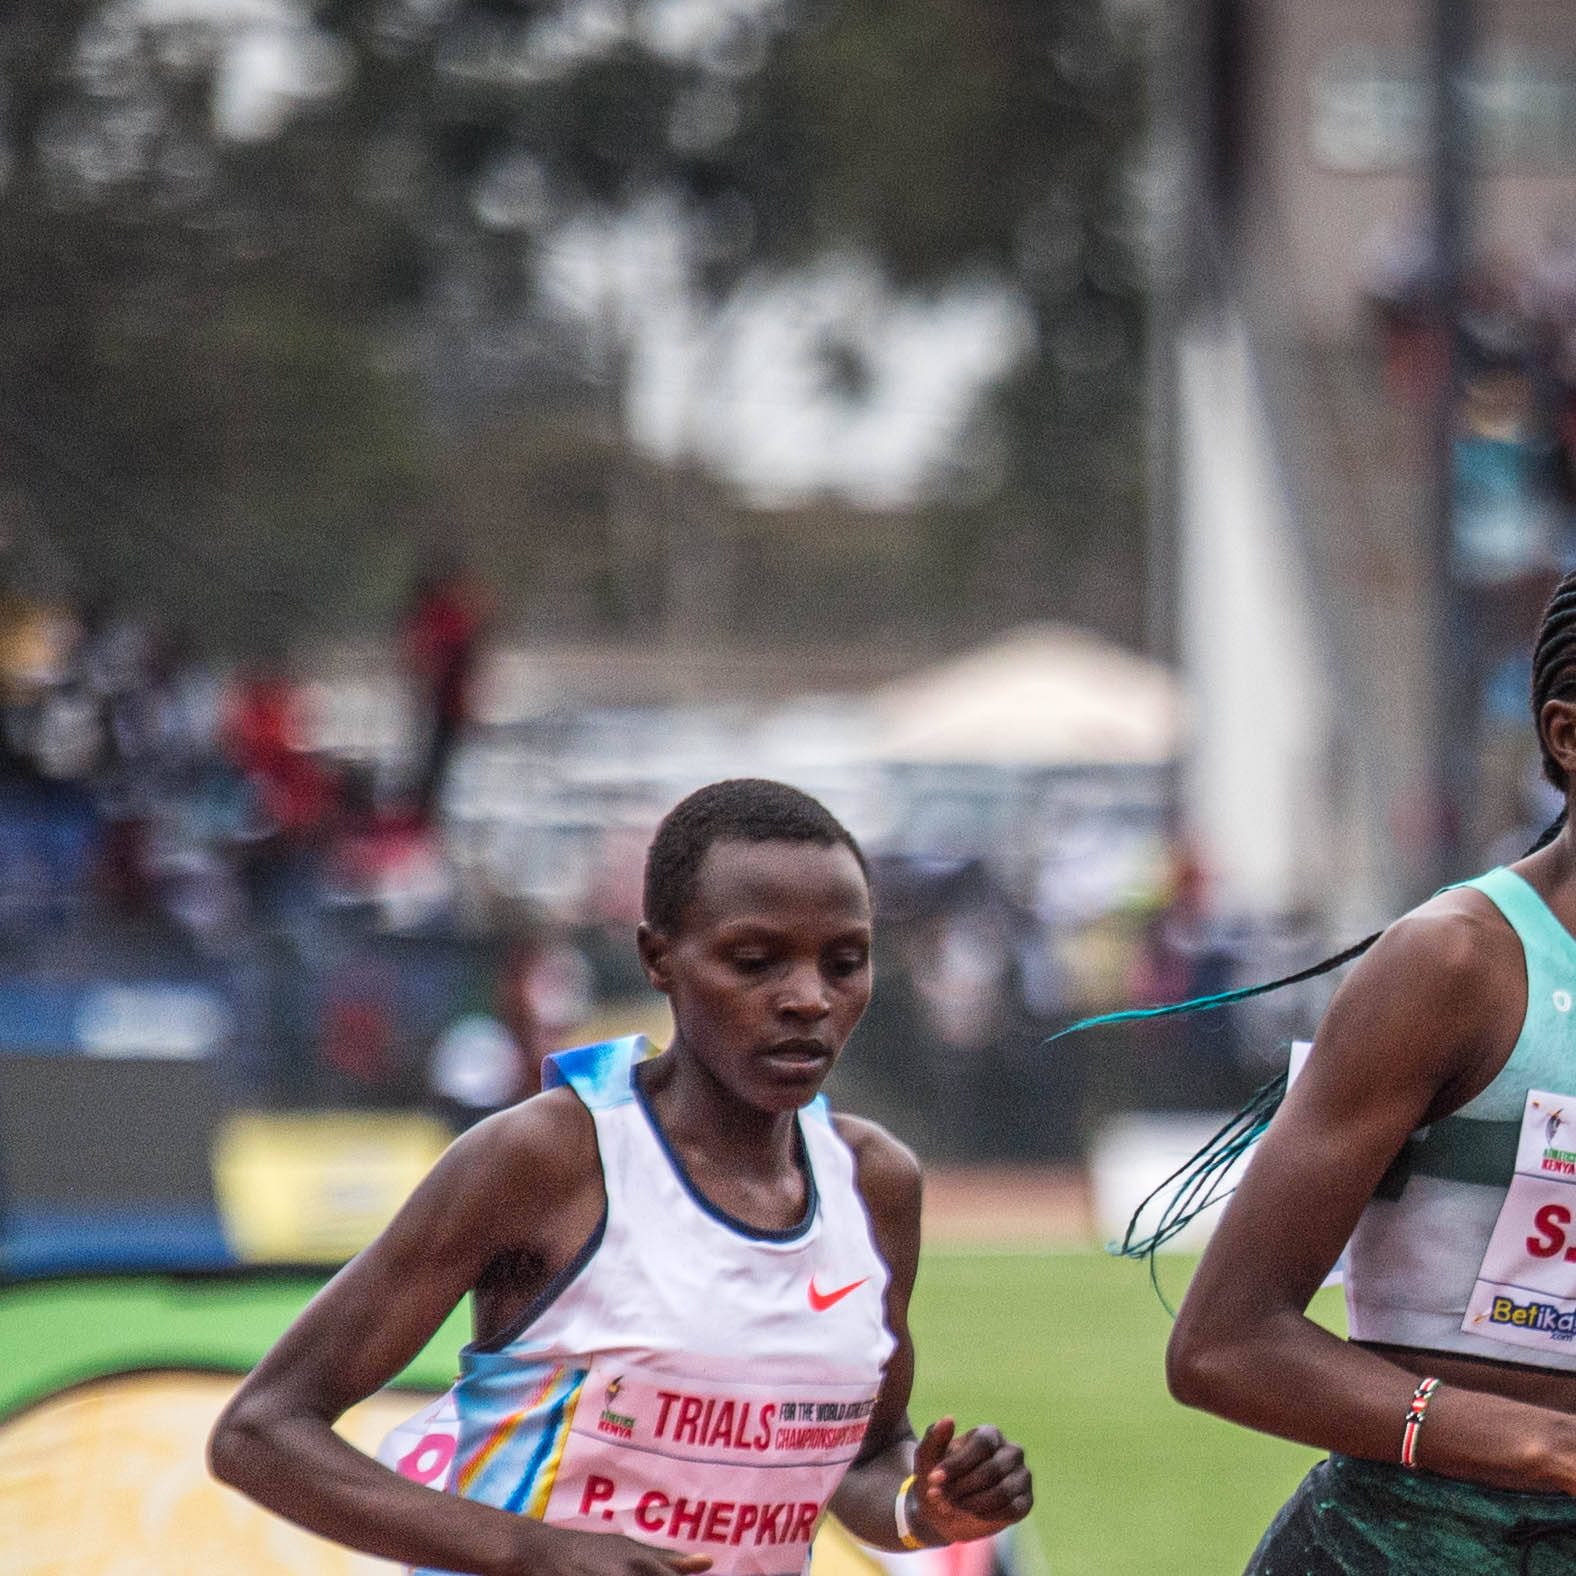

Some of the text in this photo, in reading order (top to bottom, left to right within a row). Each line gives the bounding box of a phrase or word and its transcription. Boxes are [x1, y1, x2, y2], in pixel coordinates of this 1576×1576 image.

[1542, 1157, 1576, 1176] KENYA
[653, 1391, 776, 1452] TRIALS
[779, 1402, 796, 1422] FOR
[797, 1402, 815, 1422] THE
[815, 1402, 845, 1422] WORLD
[578, 1474, 819, 1547] P. CHEPKIR
